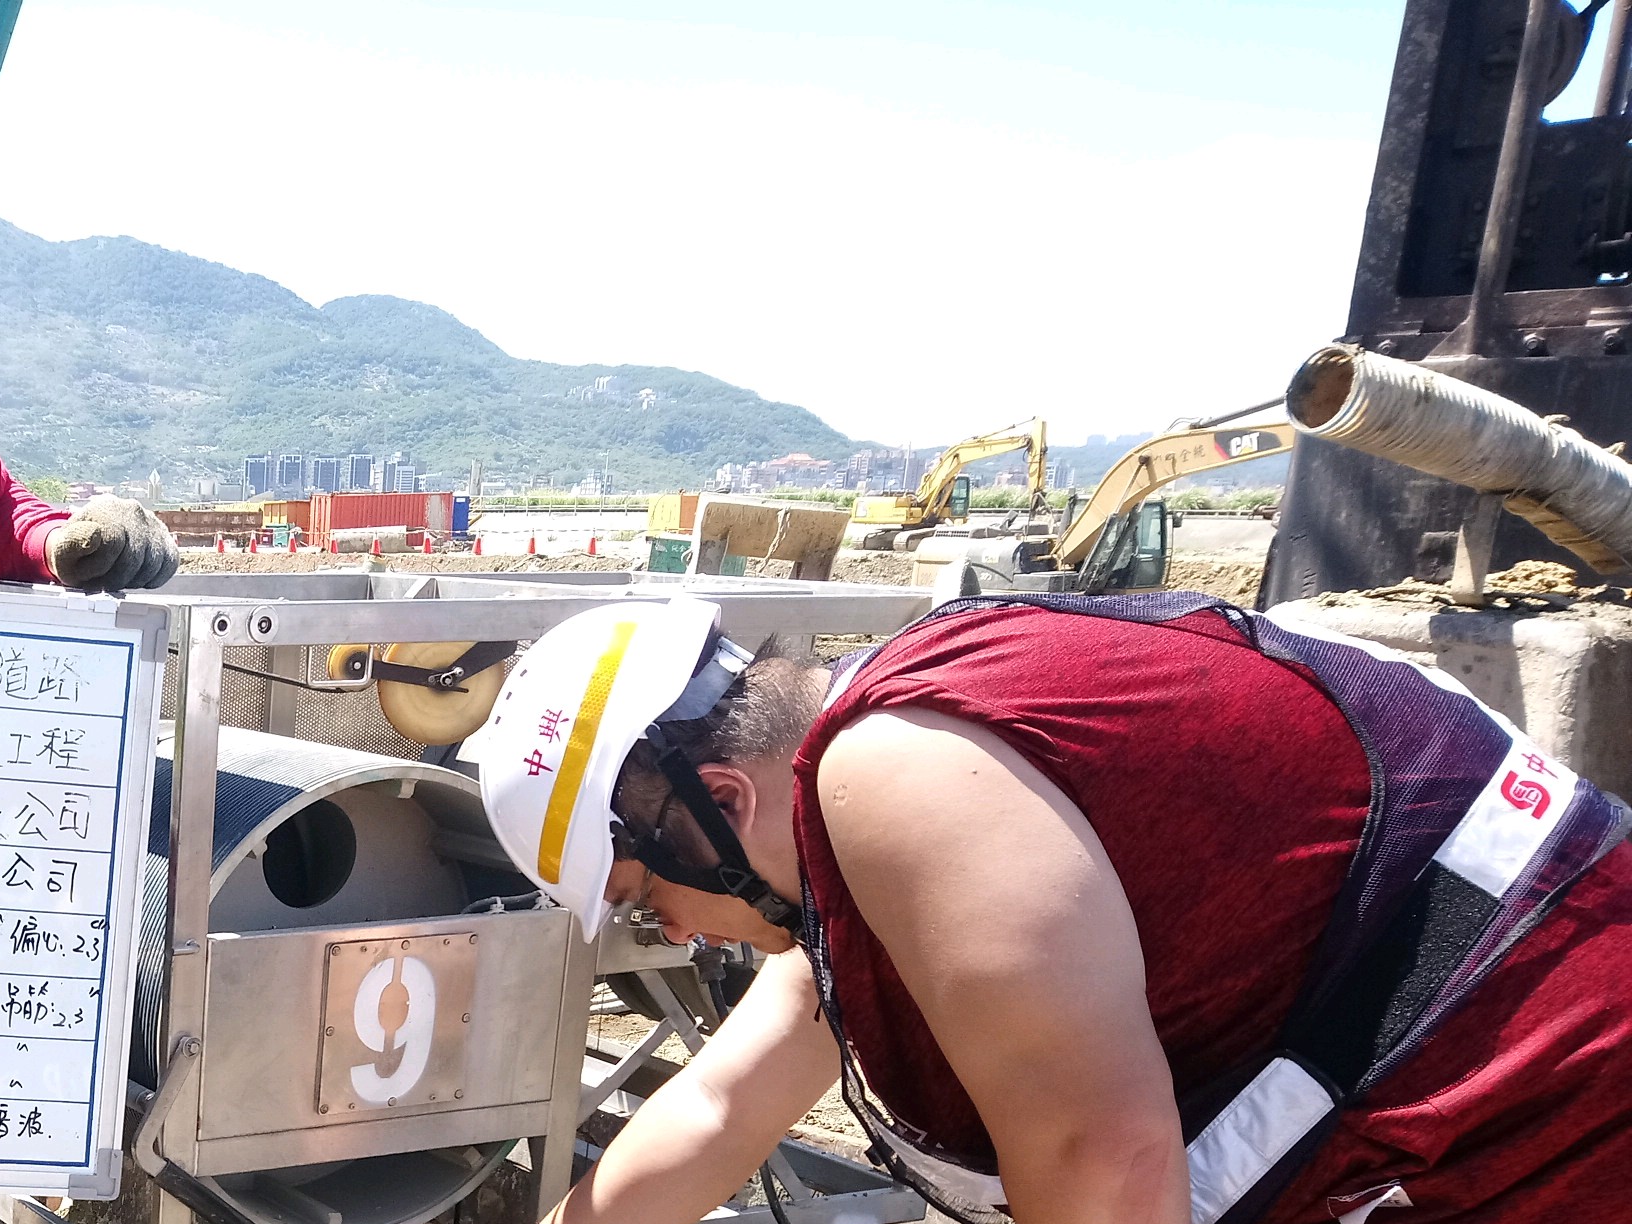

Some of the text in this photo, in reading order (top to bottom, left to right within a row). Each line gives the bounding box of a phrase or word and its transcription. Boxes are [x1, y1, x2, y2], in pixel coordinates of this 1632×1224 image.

[1230, 432, 1260, 457] CAT
[523, 708, 570, 777] 中興
[349, 955, 437, 1104] 9
